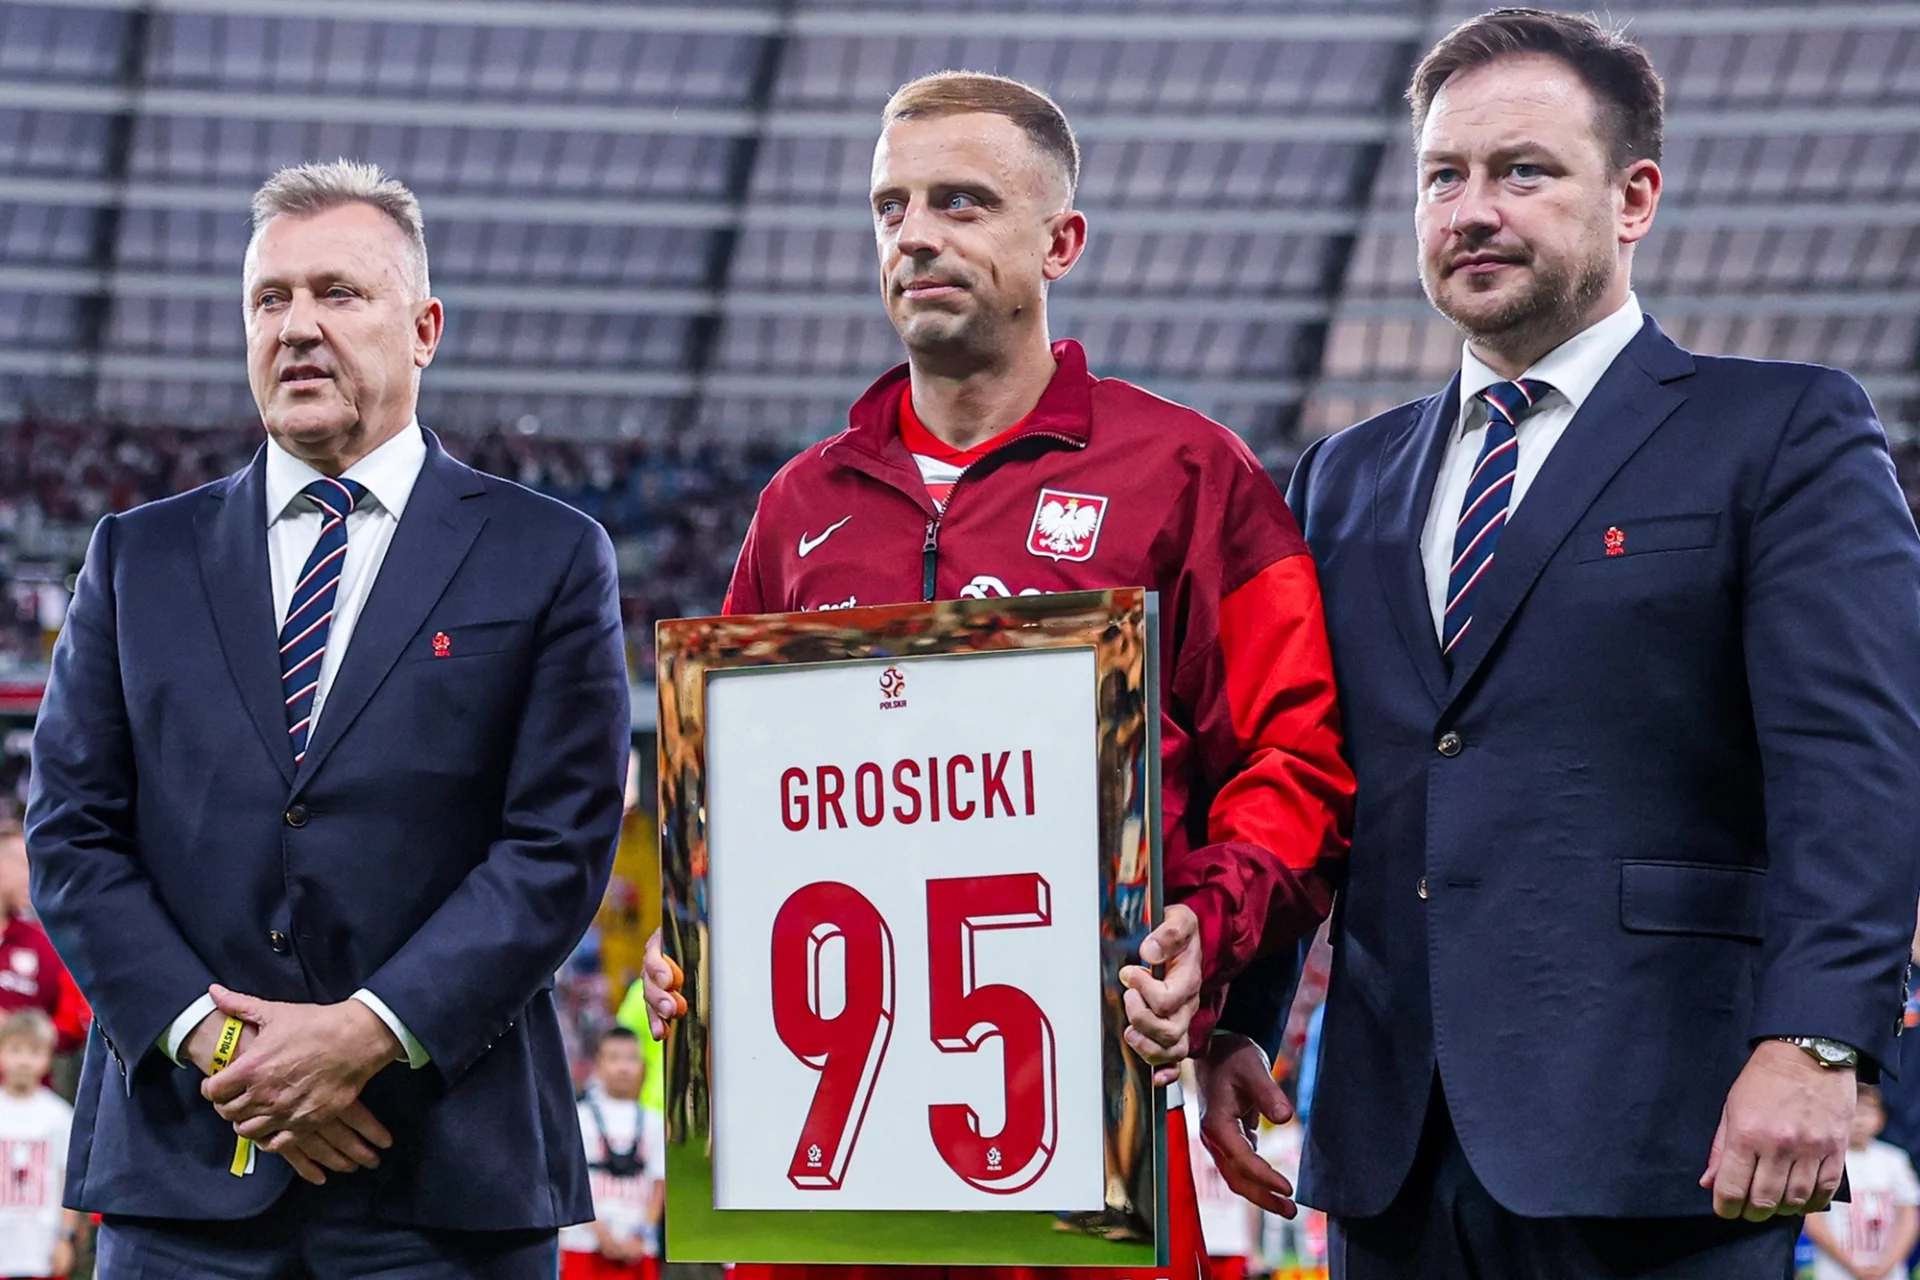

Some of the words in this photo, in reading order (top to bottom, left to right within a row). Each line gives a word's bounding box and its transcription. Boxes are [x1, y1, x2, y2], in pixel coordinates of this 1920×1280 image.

[780, 749, 1036, 832] GROSICKI
[219, 1026, 236, 1055] POLSKA
[771, 872, 1058, 1195] 95
